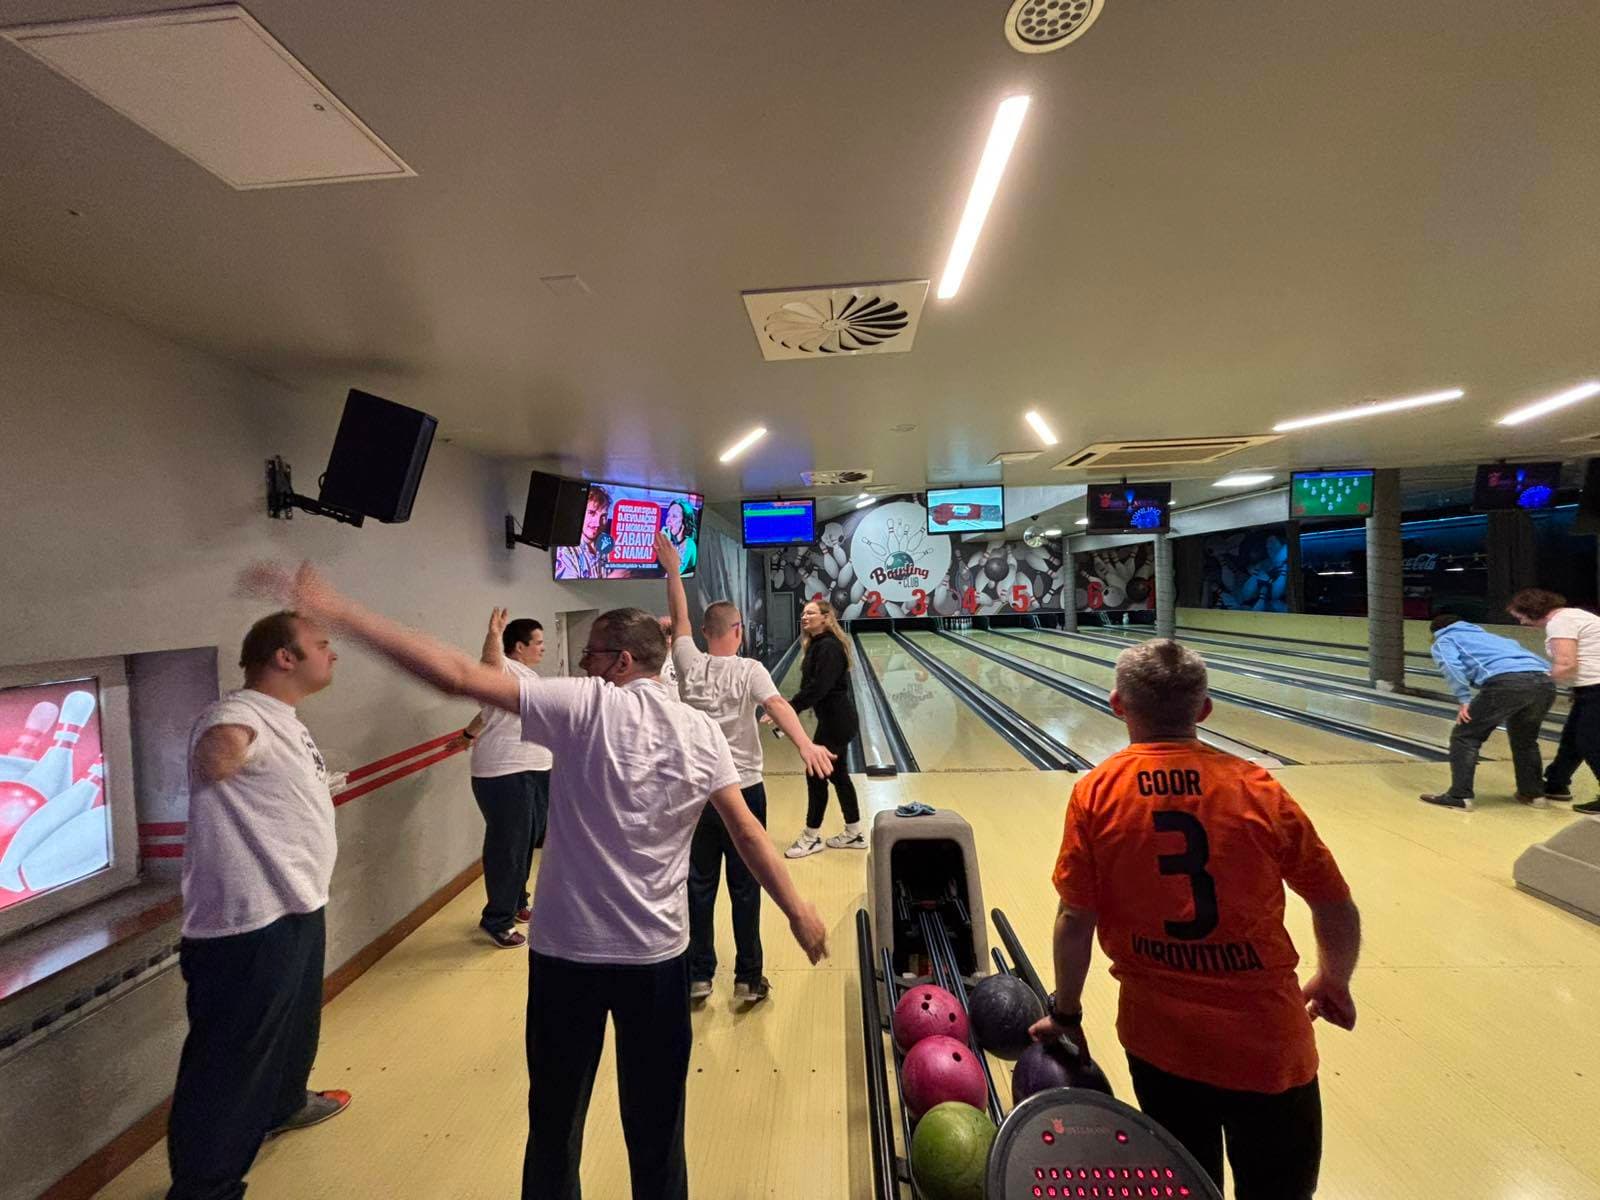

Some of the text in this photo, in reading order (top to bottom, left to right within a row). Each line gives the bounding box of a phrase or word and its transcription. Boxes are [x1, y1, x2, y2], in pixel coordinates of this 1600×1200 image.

[614, 545, 652, 559] S NAMA!
[615, 531, 654, 546] ZABAVU
[870, 563, 929, 585] Bowling
[903, 576, 920, 588] CLUB
[867, 590, 882, 617] 2
[911, 589, 927, 615] 3
[963, 586, 977, 615] 4
[1011, 584, 1030, 612] 5
[1087, 581, 1104, 609] 6
[1137, 769, 1203, 797] COOR
[1152, 810, 1219, 941] 3
[1132, 934, 1263, 972] VIROVITICA
